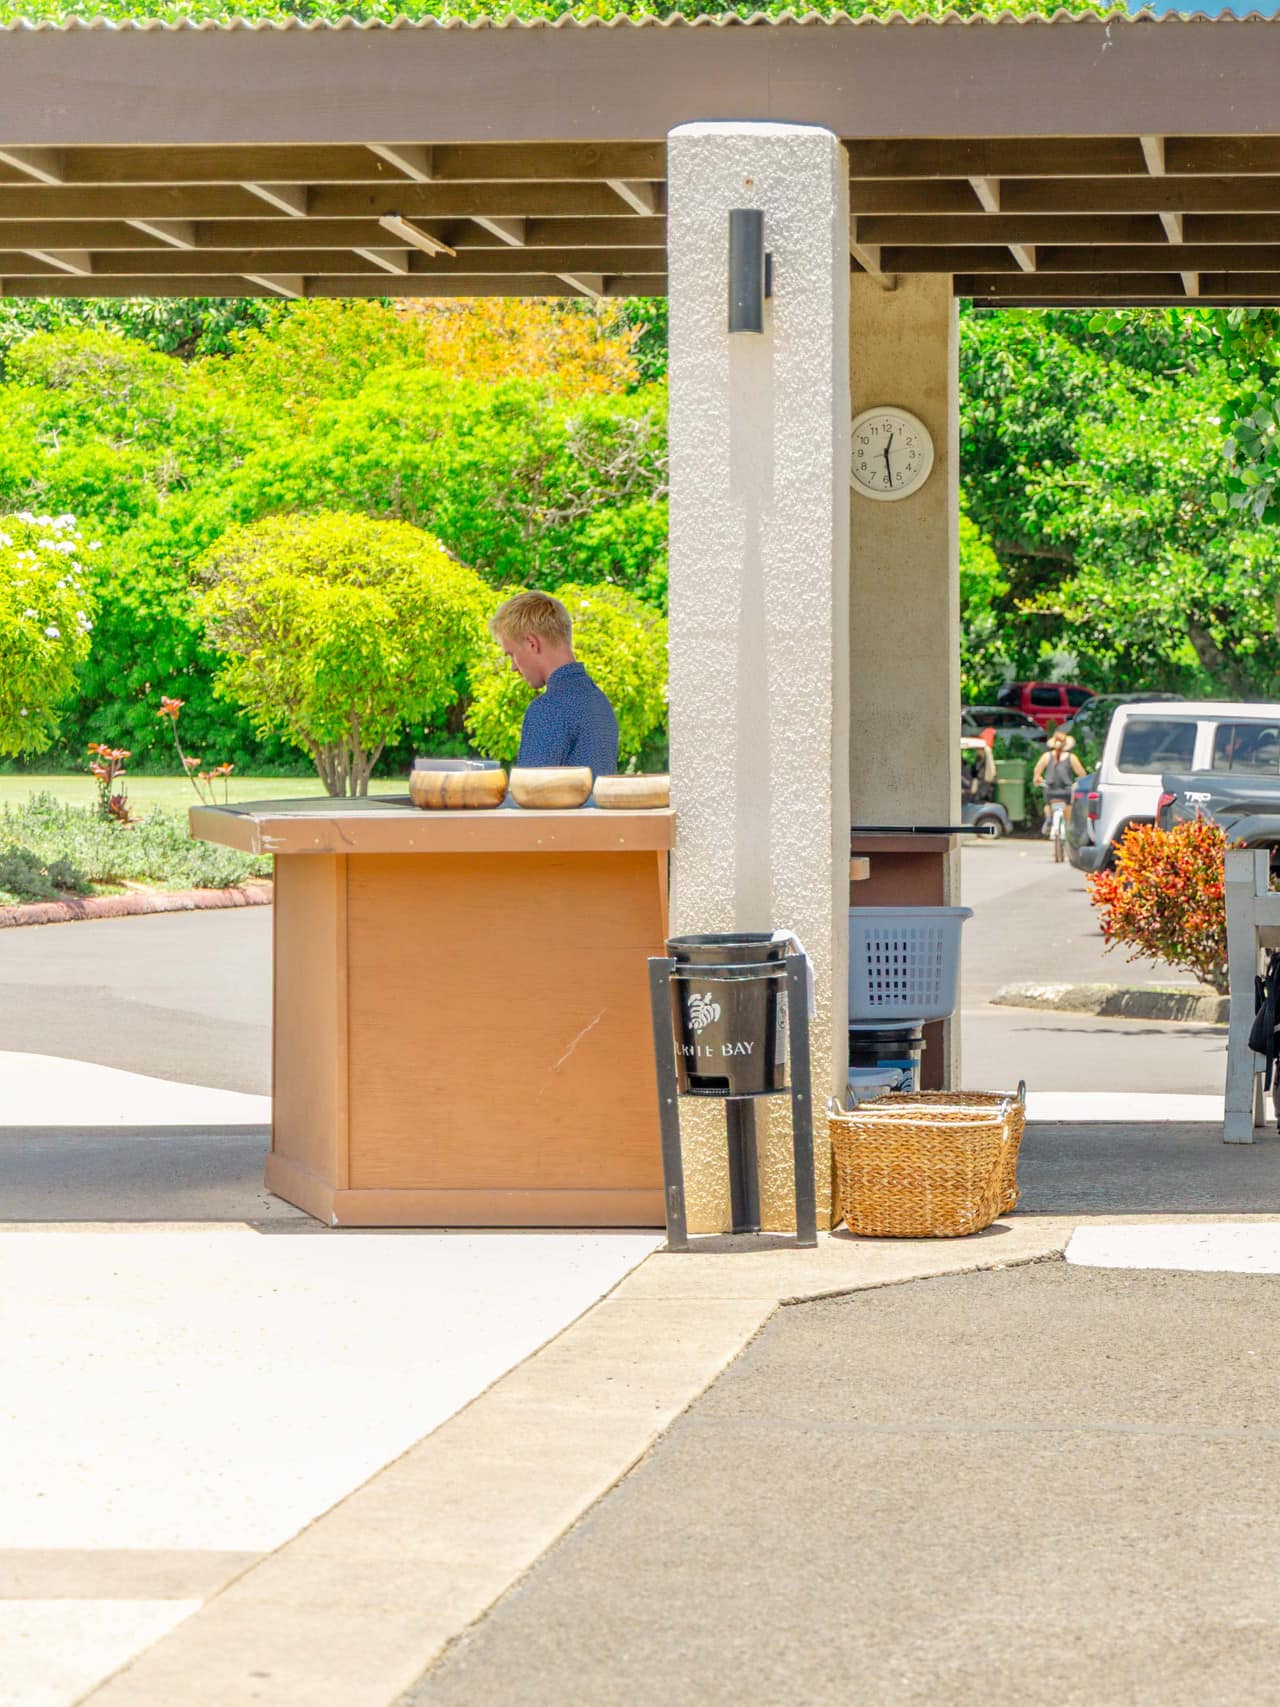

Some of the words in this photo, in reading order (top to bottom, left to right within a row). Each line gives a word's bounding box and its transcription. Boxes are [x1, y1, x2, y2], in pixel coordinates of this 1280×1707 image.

[870, 427, 879, 436] 11
[882, 424, 893, 433] 12
[860, 436, 870, 445] 10
[905, 437, 912, 446] 2
[857, 449, 864, 458] 9
[909, 450, 916, 459] 3
[860, 462, 867, 471] 8
[905, 463, 912, 472] 4
[870, 471, 877, 480] 7
[882, 475, 889, 484] 6
[895, 472, 902, 481] 5
[721, 1041, 755, 1057] BAY
